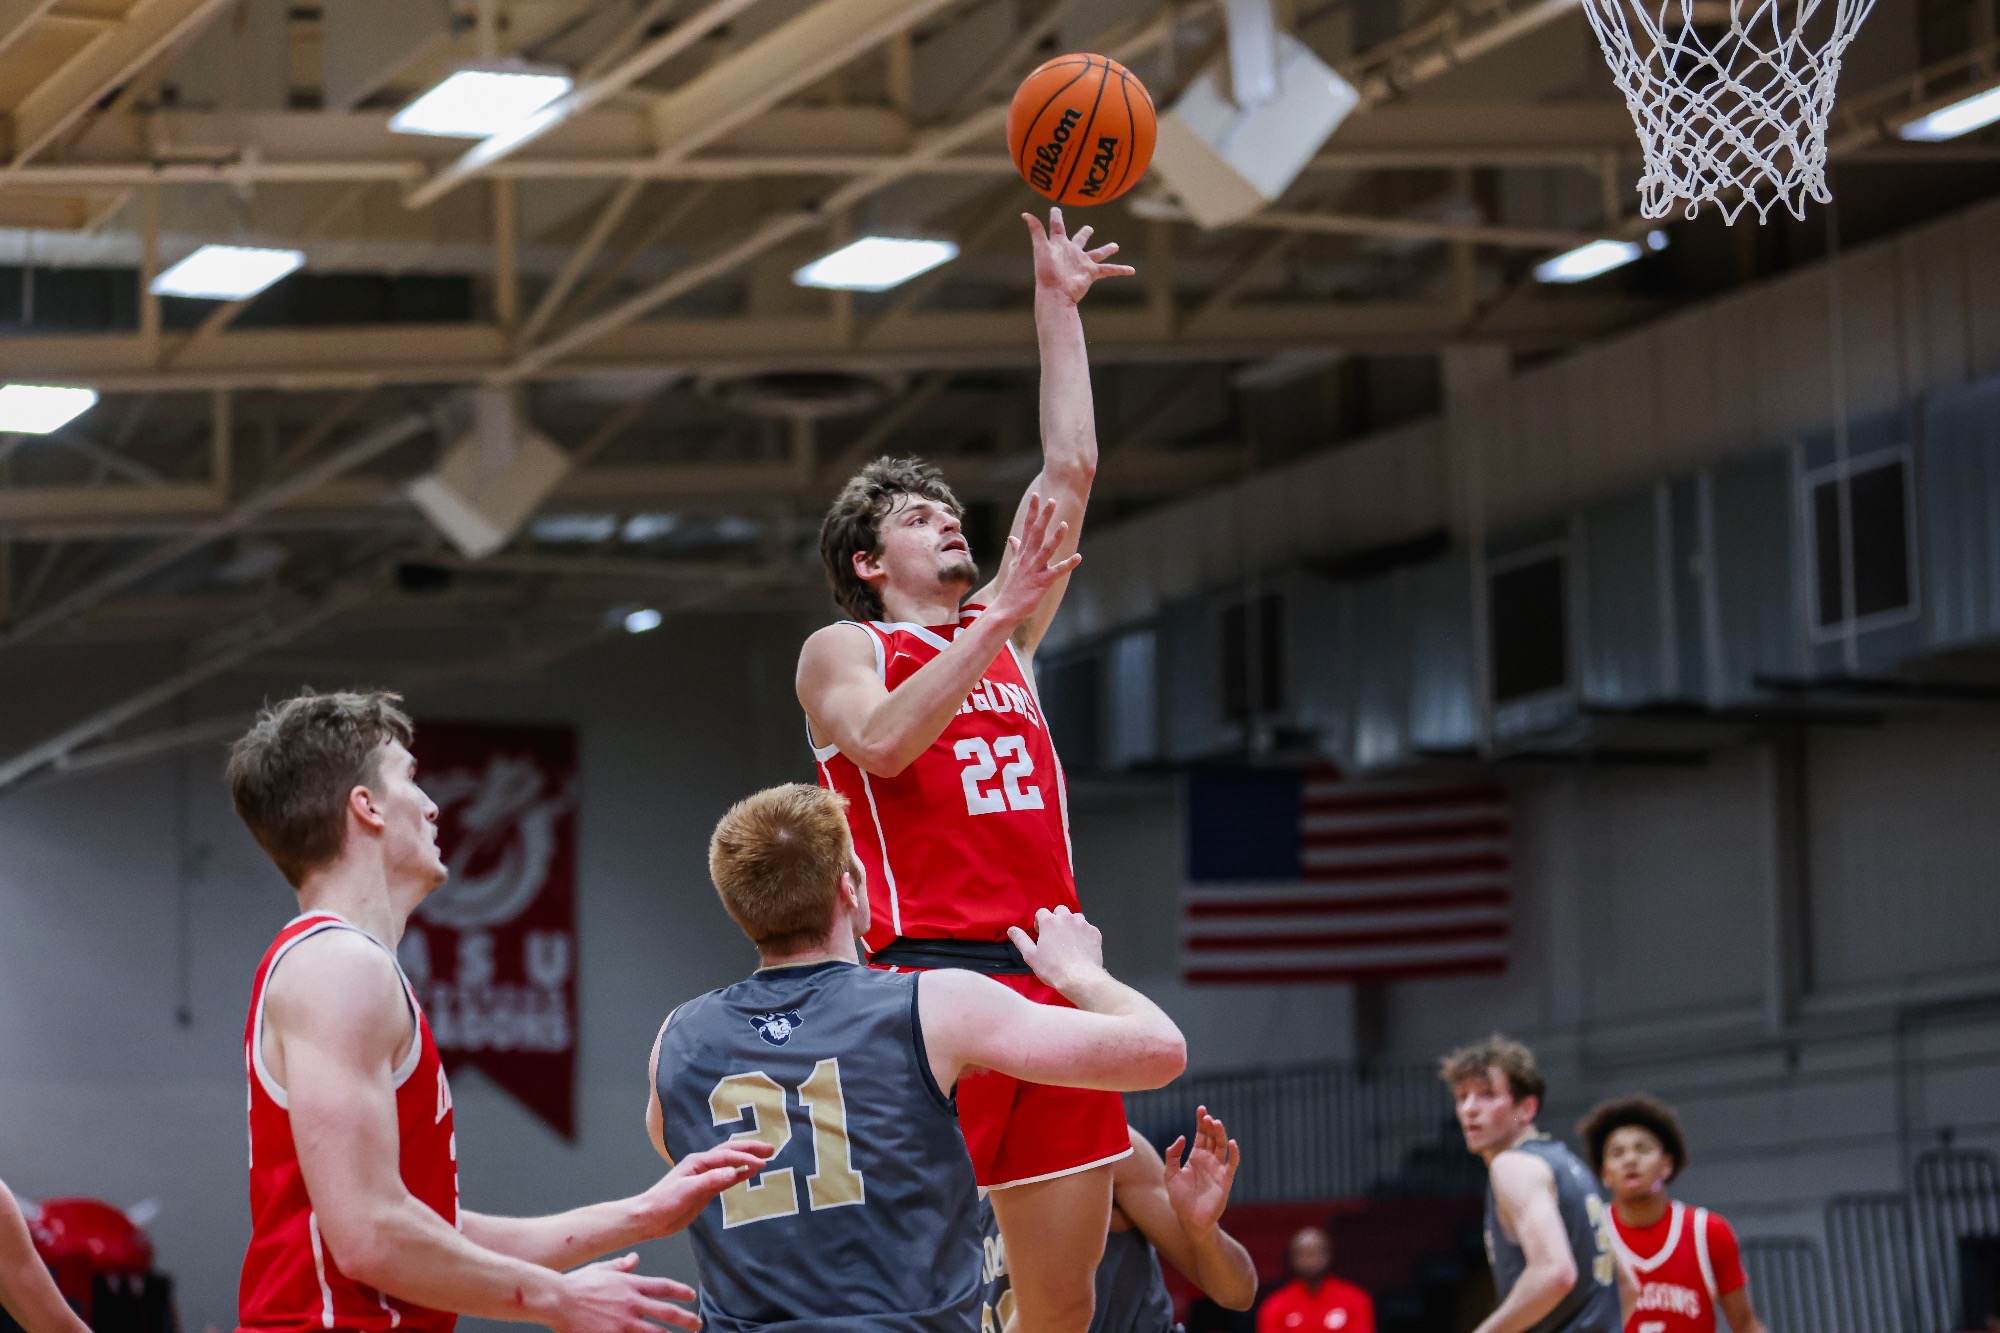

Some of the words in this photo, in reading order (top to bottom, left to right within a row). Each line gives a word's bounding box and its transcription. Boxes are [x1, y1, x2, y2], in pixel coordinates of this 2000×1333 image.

[1030, 108, 1083, 192] Wilson
[1078, 136, 1119, 198] NCAA
[952, 735, 1045, 816] 22
[707, 1057, 866, 1230] 21
